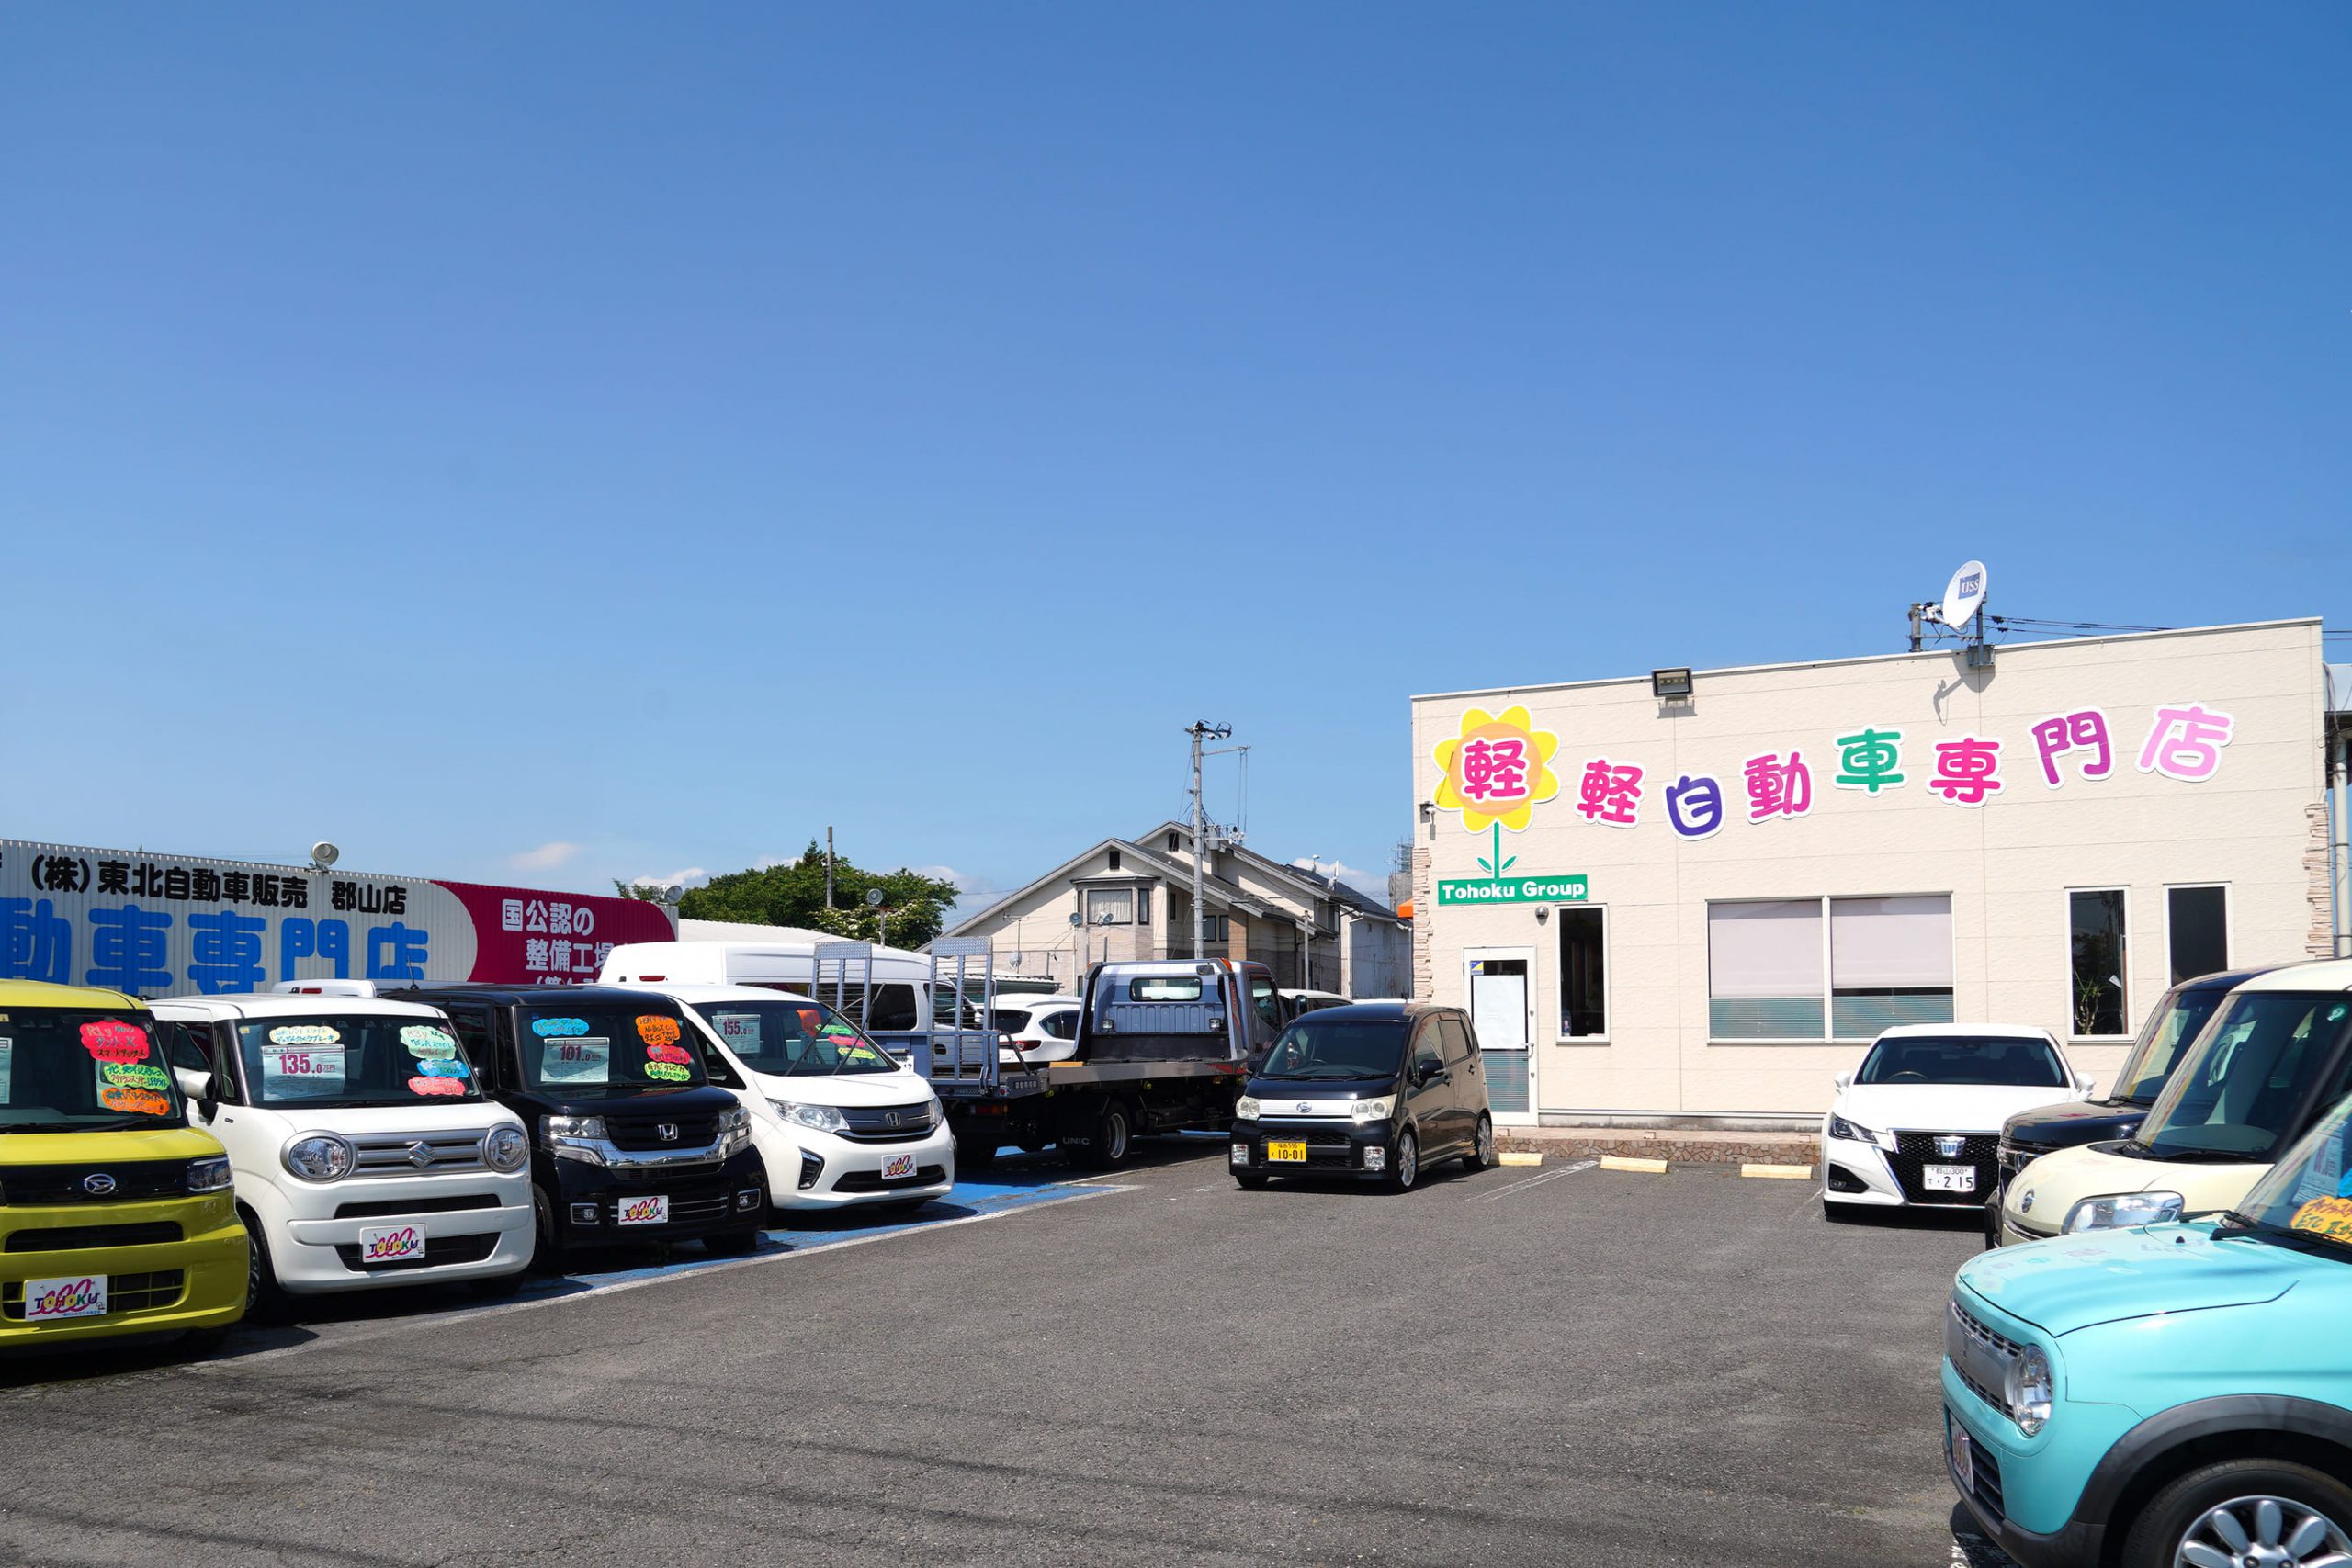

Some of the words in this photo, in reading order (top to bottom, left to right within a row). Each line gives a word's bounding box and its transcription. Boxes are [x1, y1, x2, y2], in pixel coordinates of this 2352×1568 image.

[1962, 579, 1979, 593] USS
[1464, 739, 1526, 800] 軽
[1577, 706, 2231, 837] 軽自動車専門店
[331, 880, 407, 915] 郡山店
[1442, 885, 1515, 899] Tohoku
[1522, 879, 1585, 897] Group
[502, 898, 594, 936] 国公認の
[1062, 1136, 1090, 1145] UNIC
[624, 1206, 663, 1217] TOHOKU
[369, 1239, 420, 1253] TOHOKU
[34, 1292, 101, 1309] TOHOKU
